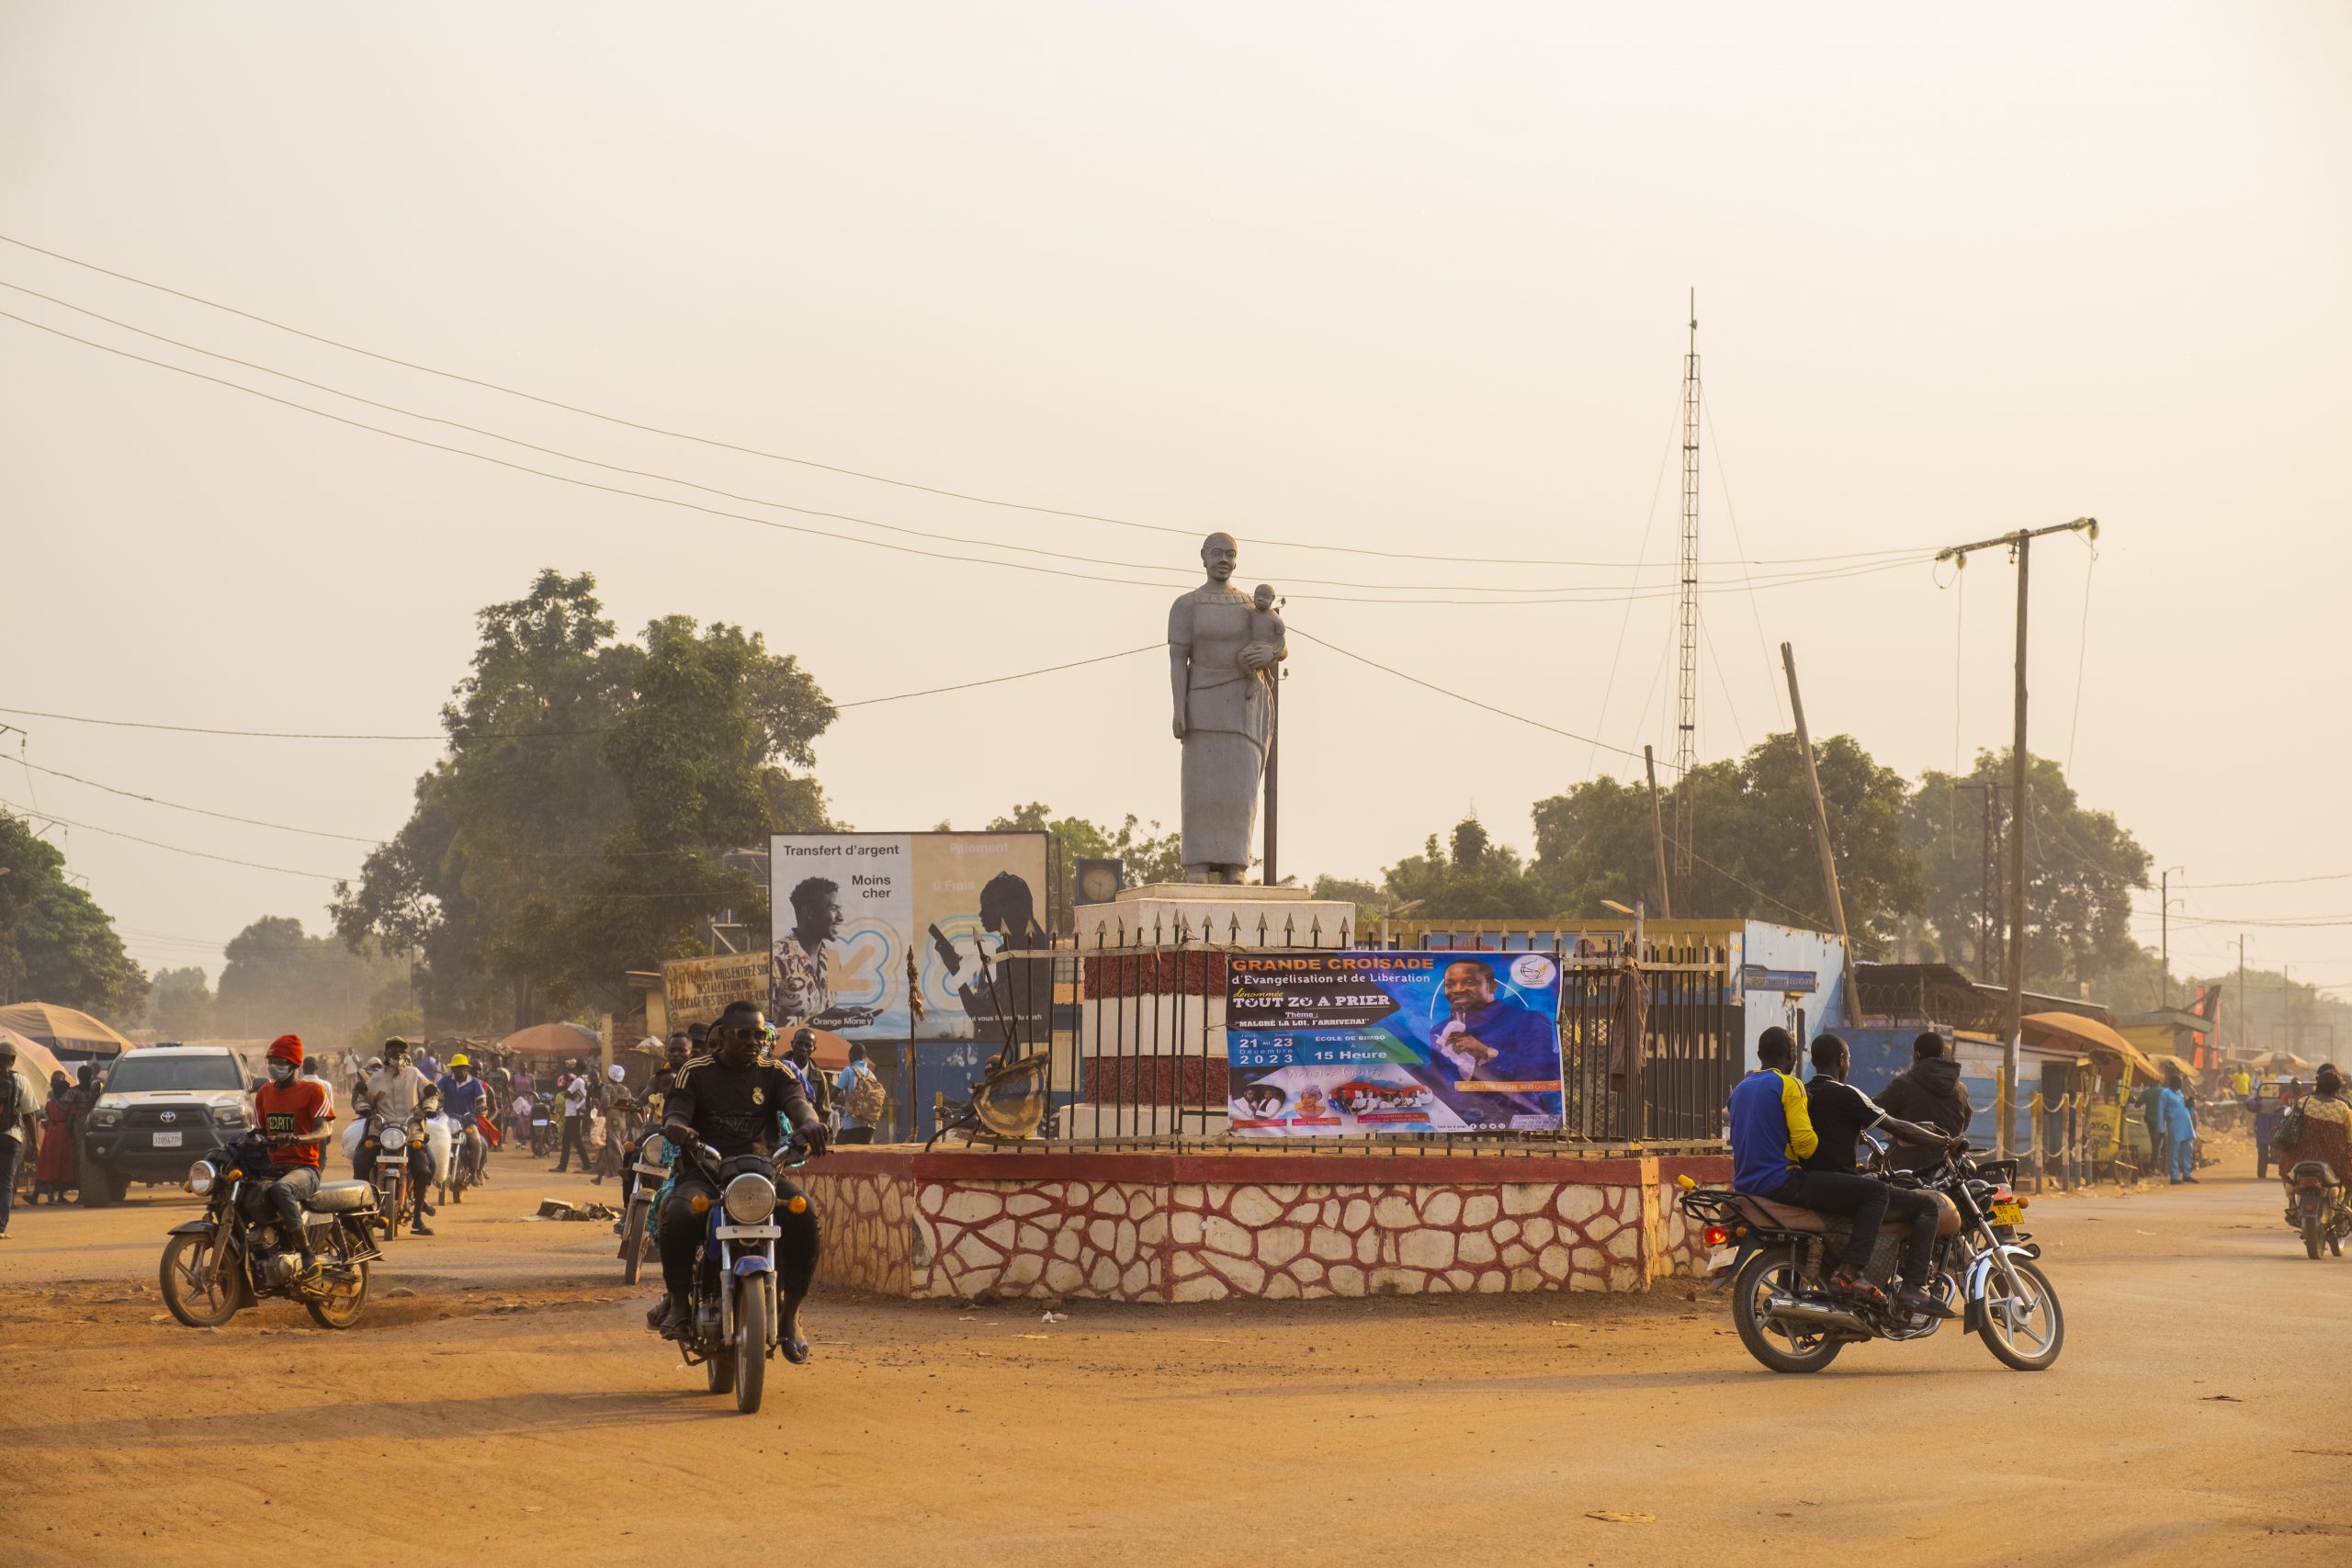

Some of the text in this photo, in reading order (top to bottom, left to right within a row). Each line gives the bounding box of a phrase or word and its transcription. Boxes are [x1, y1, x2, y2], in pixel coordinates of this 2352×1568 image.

[784, 845, 899, 857] Transfert d’argent
[852, 874, 891, 886] Moins
[945, 880, 976, 891] Frais
[862, 888, 891, 898] cher
[1232, 958, 1434, 971] GRANDE CROISADE
[714, 967, 731, 980] VOUS
[731, 964, 755, 978] ENTREZ
[757, 963, 770, 976] SUR
[1337, 975, 1347, 983] et
[1351, 974, 1365, 983] de
[1370, 973, 1430, 983] Libération
[1233, 987, 1284, 998] dénommée
[670, 996, 702, 1010] STOCKAGE
[703, 995, 716, 1007] DES
[1233, 998, 1283, 1008] TOUT
[1317, 996, 1330, 1006] A
[1335, 995, 1390, 1007] PRIER
[813, 1017, 872, 1026] Orange Money
[1239, 1039, 1258, 1048] 21
[1273, 1038, 1294, 1047] 23
[1239, 1055, 1294, 1065] 2023
[1315, 1050, 1387, 1060] 15 Heure
[266, 1115, 295, 1131] SECURITY
